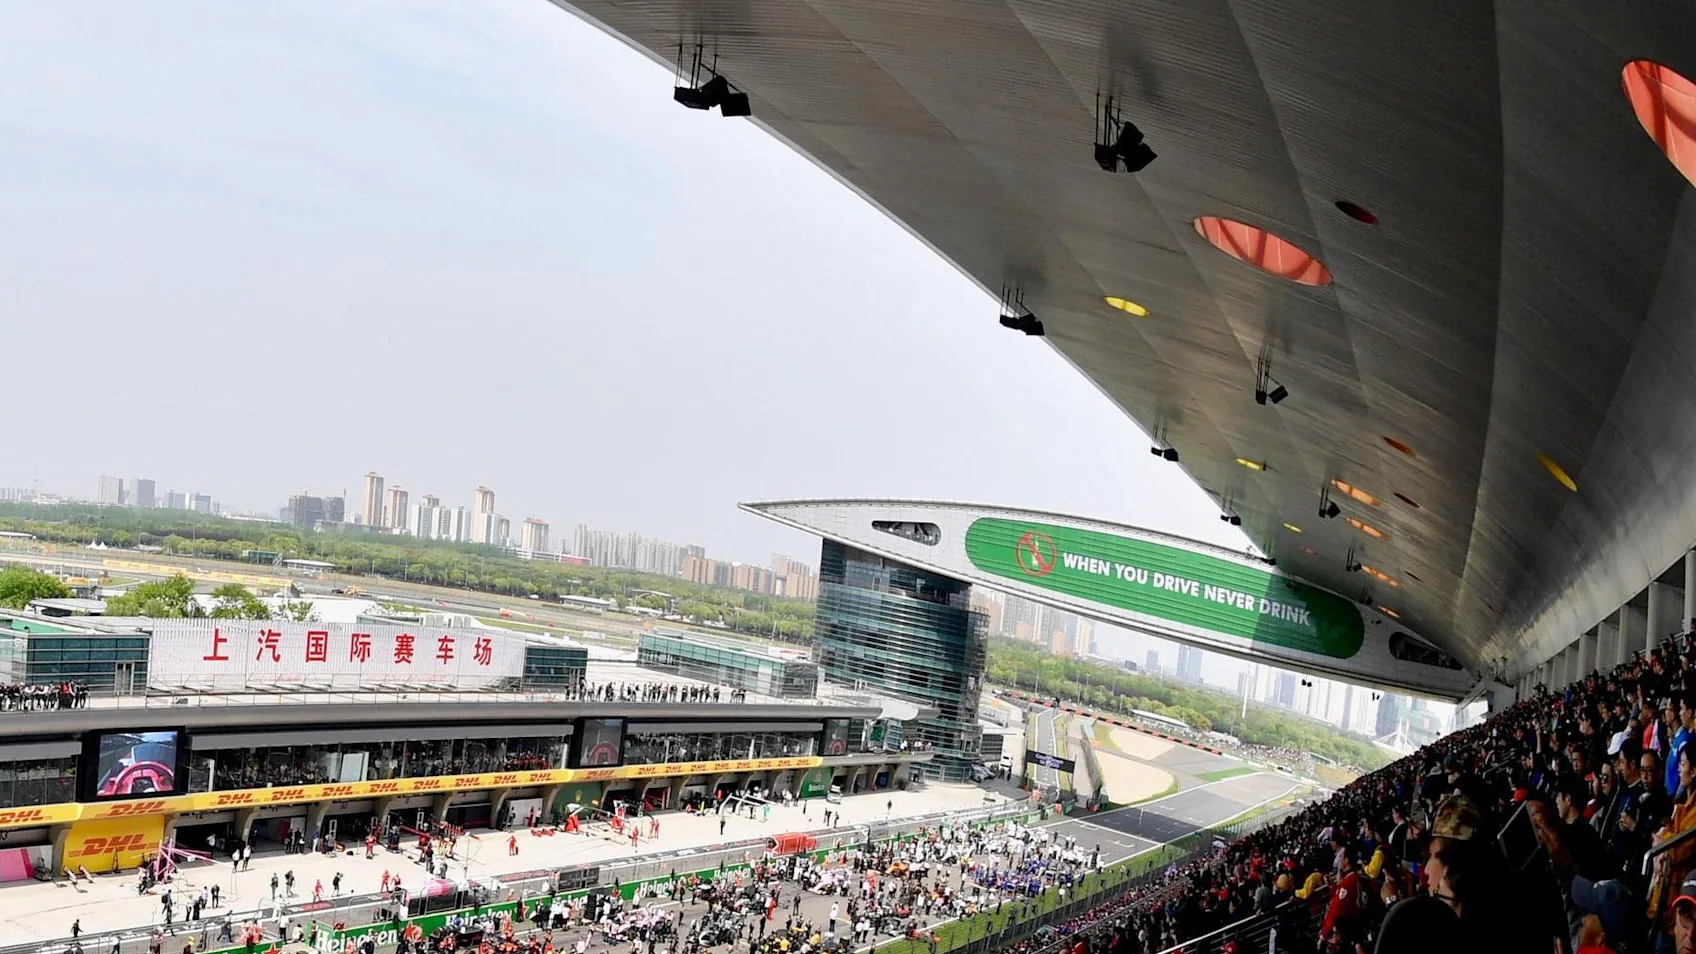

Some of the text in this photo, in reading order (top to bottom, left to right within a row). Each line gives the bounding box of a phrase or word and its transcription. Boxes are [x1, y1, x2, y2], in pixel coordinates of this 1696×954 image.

[1062, 552, 1311, 627] WHEN YOU DRIVE NEVER DRINK
[203, 627, 492, 667] 上汽国际赛车场
[413, 779, 441, 790] DHL
[455, 777, 480, 787] DHL
[493, 775, 516, 784] DHL
[322, 785, 354, 797] DHL
[369, 782, 399, 793] DHL
[216, 793, 254, 805] DHL
[270, 789, 305, 801] DHL
[106, 801, 165, 816] DHL
[81, 833, 147, 856] DHL
